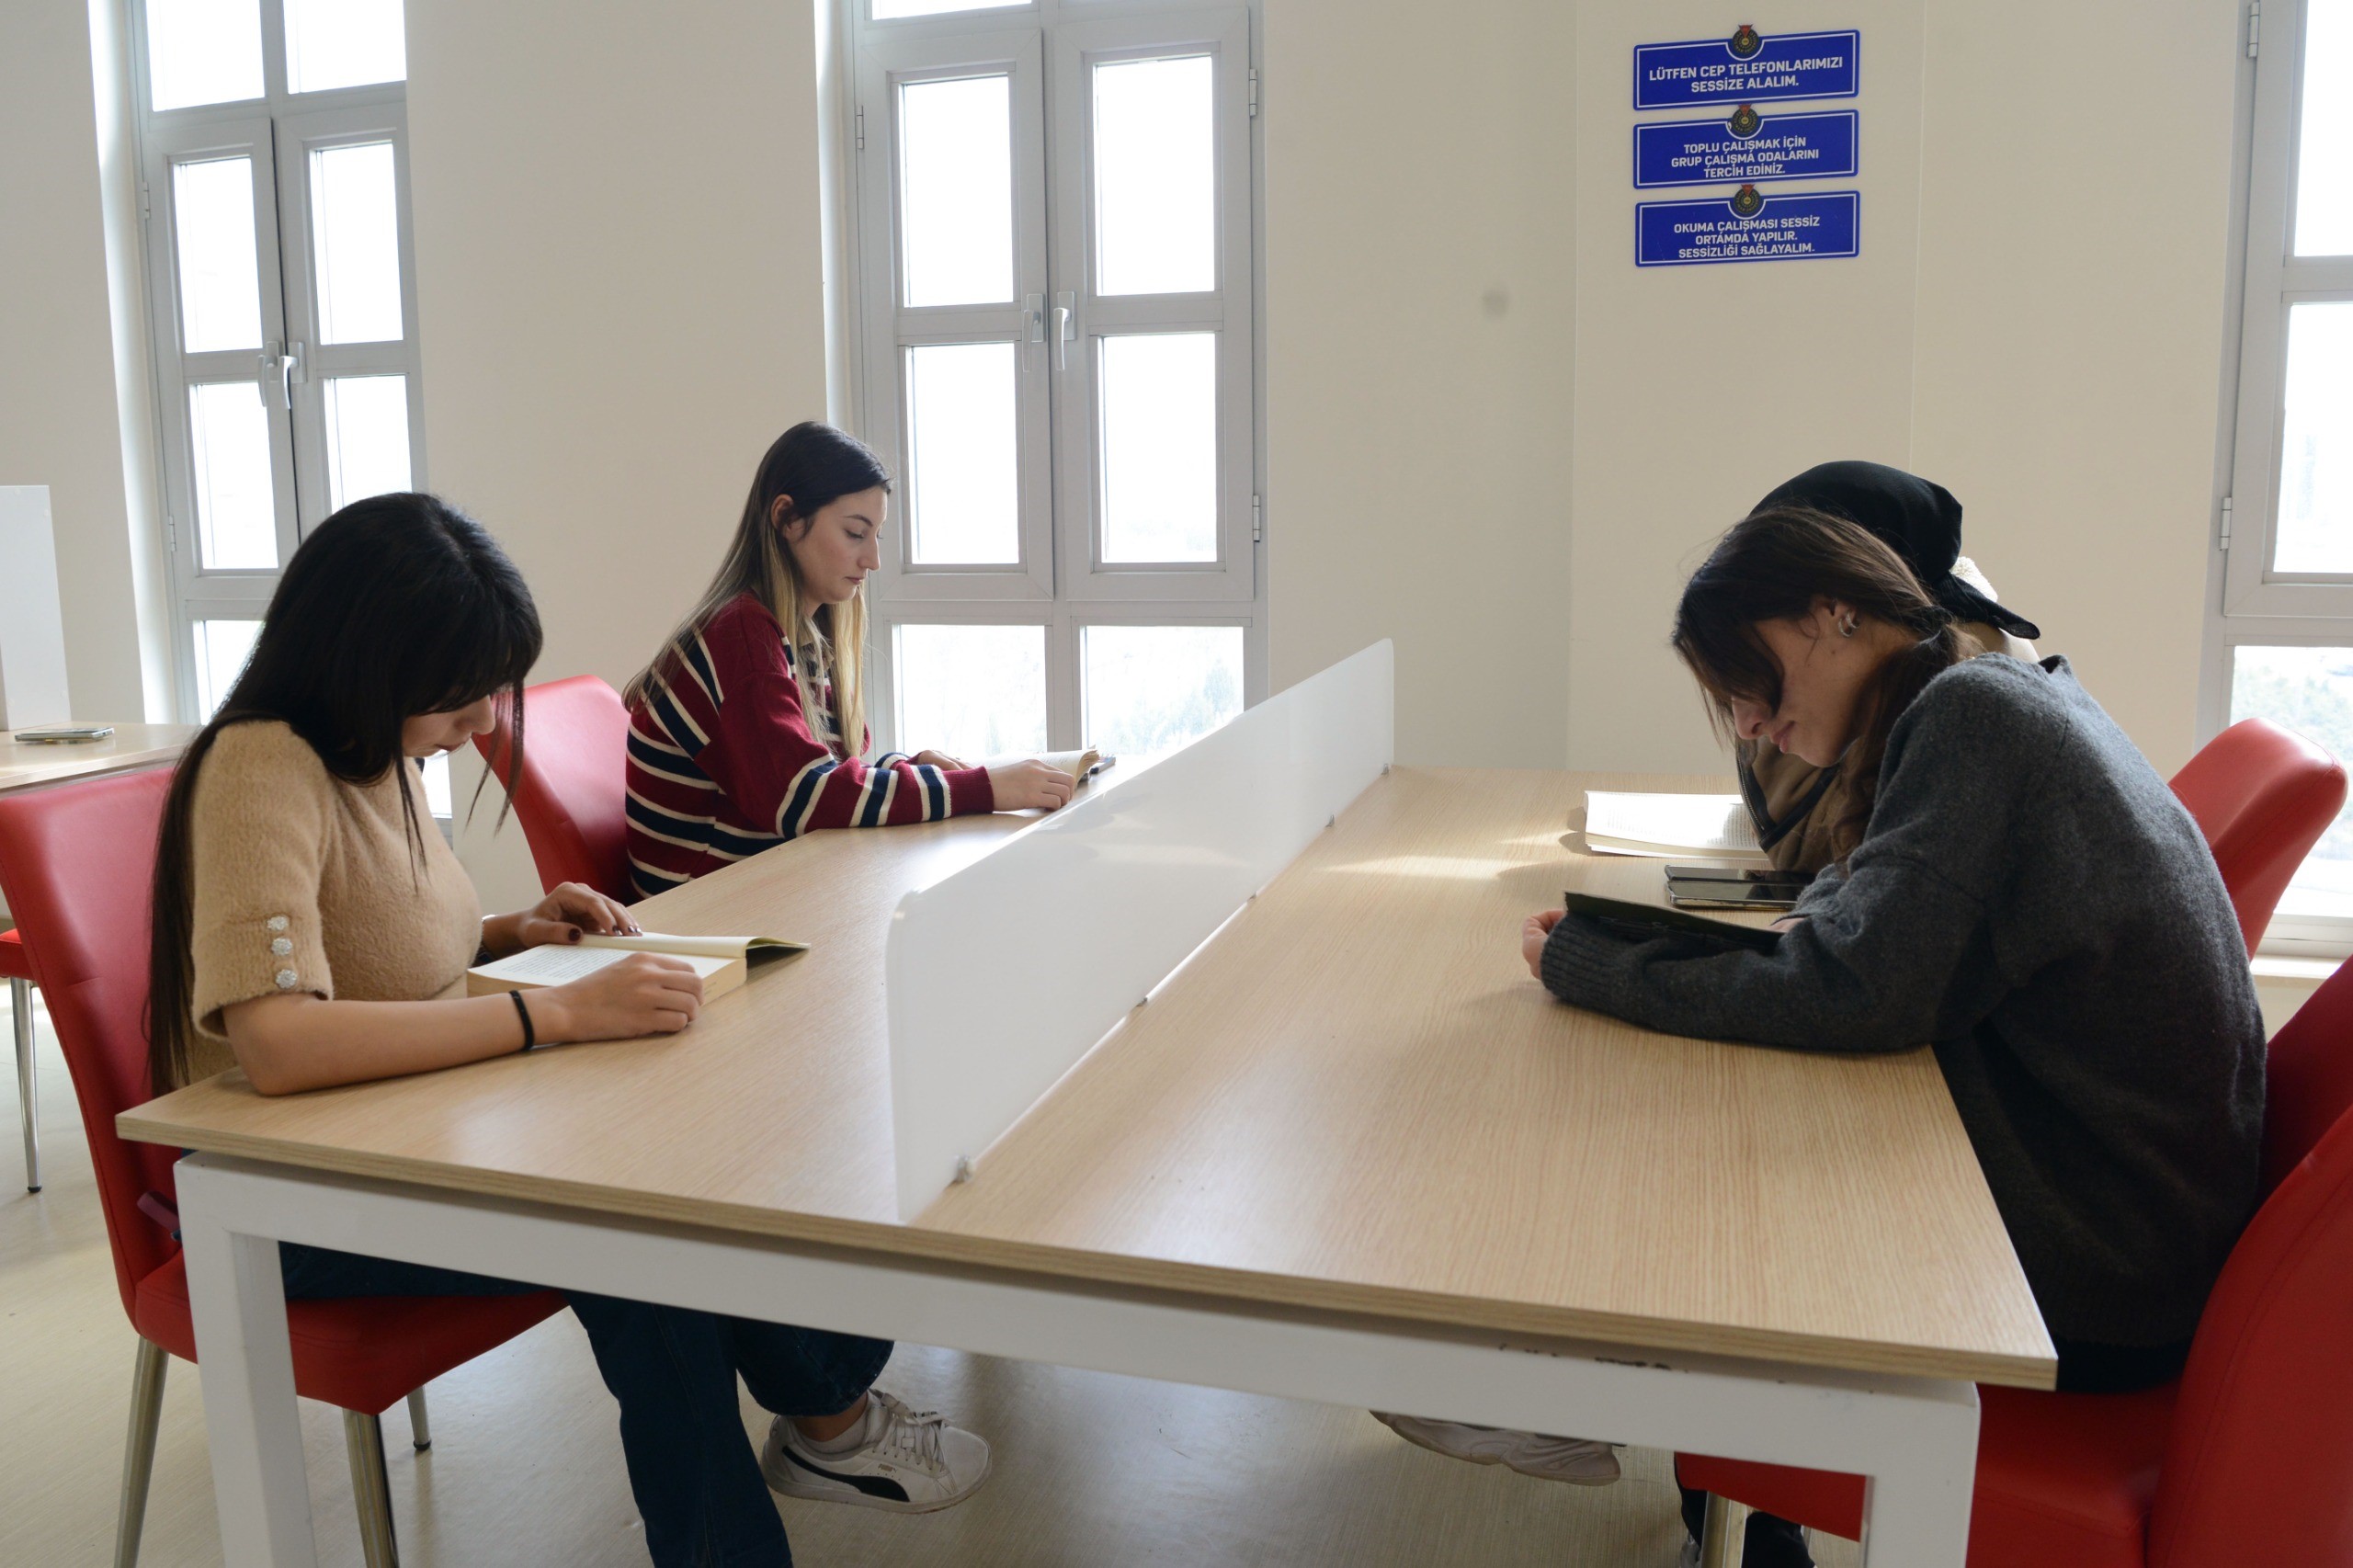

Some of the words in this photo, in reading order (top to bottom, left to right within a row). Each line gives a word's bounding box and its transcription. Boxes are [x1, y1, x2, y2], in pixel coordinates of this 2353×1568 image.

[1649, 66, 1697, 81] LÜTFEN
[1699, 64, 1726, 77] CEP
[1728, 56, 1843, 75] TELEFONLARIMIZI
[1690, 77, 1744, 93] SESSİZE
[1746, 75, 1800, 89] ALALIM.
[1684, 142, 1720, 153] TOPLU
[1722, 138, 1780, 155] ÇALIŞMAK
[1783, 135, 1806, 151] İÇİN
[1671, 156, 1702, 167] GRUP
[1704, 153, 1755, 171] ÇALIŞMA
[1757, 149, 1819, 162] ODALARINI
[1703, 165, 1744, 178] TERCİH
[1746, 164, 1786, 176] EDİNİZ.
[1674, 222, 1714, 233] OKUMA
[1717, 219, 1779, 237] ÇALIŞMASI
[1780, 214, 1820, 228] SESSİZ
[1695, 233, 1749, 245] ORTAMDA
[1752, 231, 1798, 243] YAPILIR.
[1678, 244, 1738, 258] SESSİZLİĞİ
[1741, 242, 1815, 256] SAĞLAYALIM.
